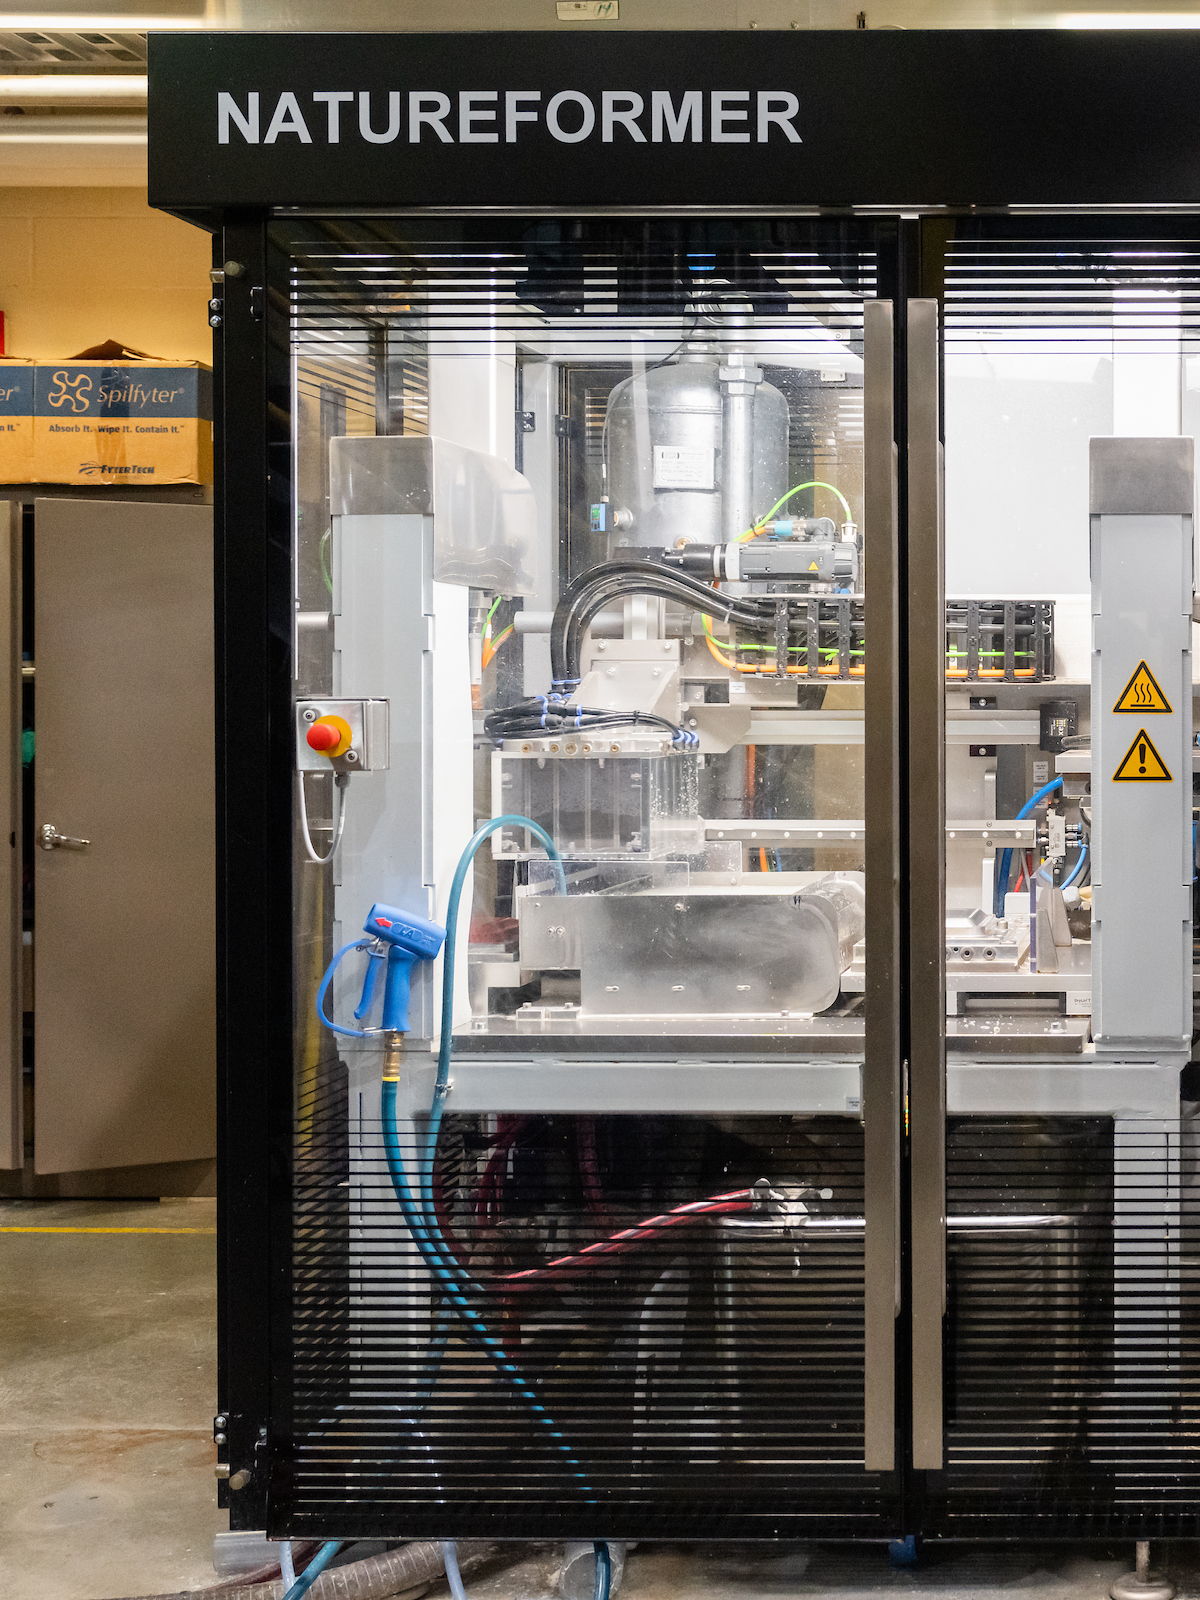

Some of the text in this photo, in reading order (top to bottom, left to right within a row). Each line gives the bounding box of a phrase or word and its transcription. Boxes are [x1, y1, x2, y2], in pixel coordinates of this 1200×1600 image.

[217, 90, 803, 144] NATUREFORMER
[49, 424, 80, 433] Absorb
[83, 425, 93, 433] It.
[97, 425, 120, 434] Wipe
[122, 425, 132, 433] It.
[135, 425, 168, 434] Contain
